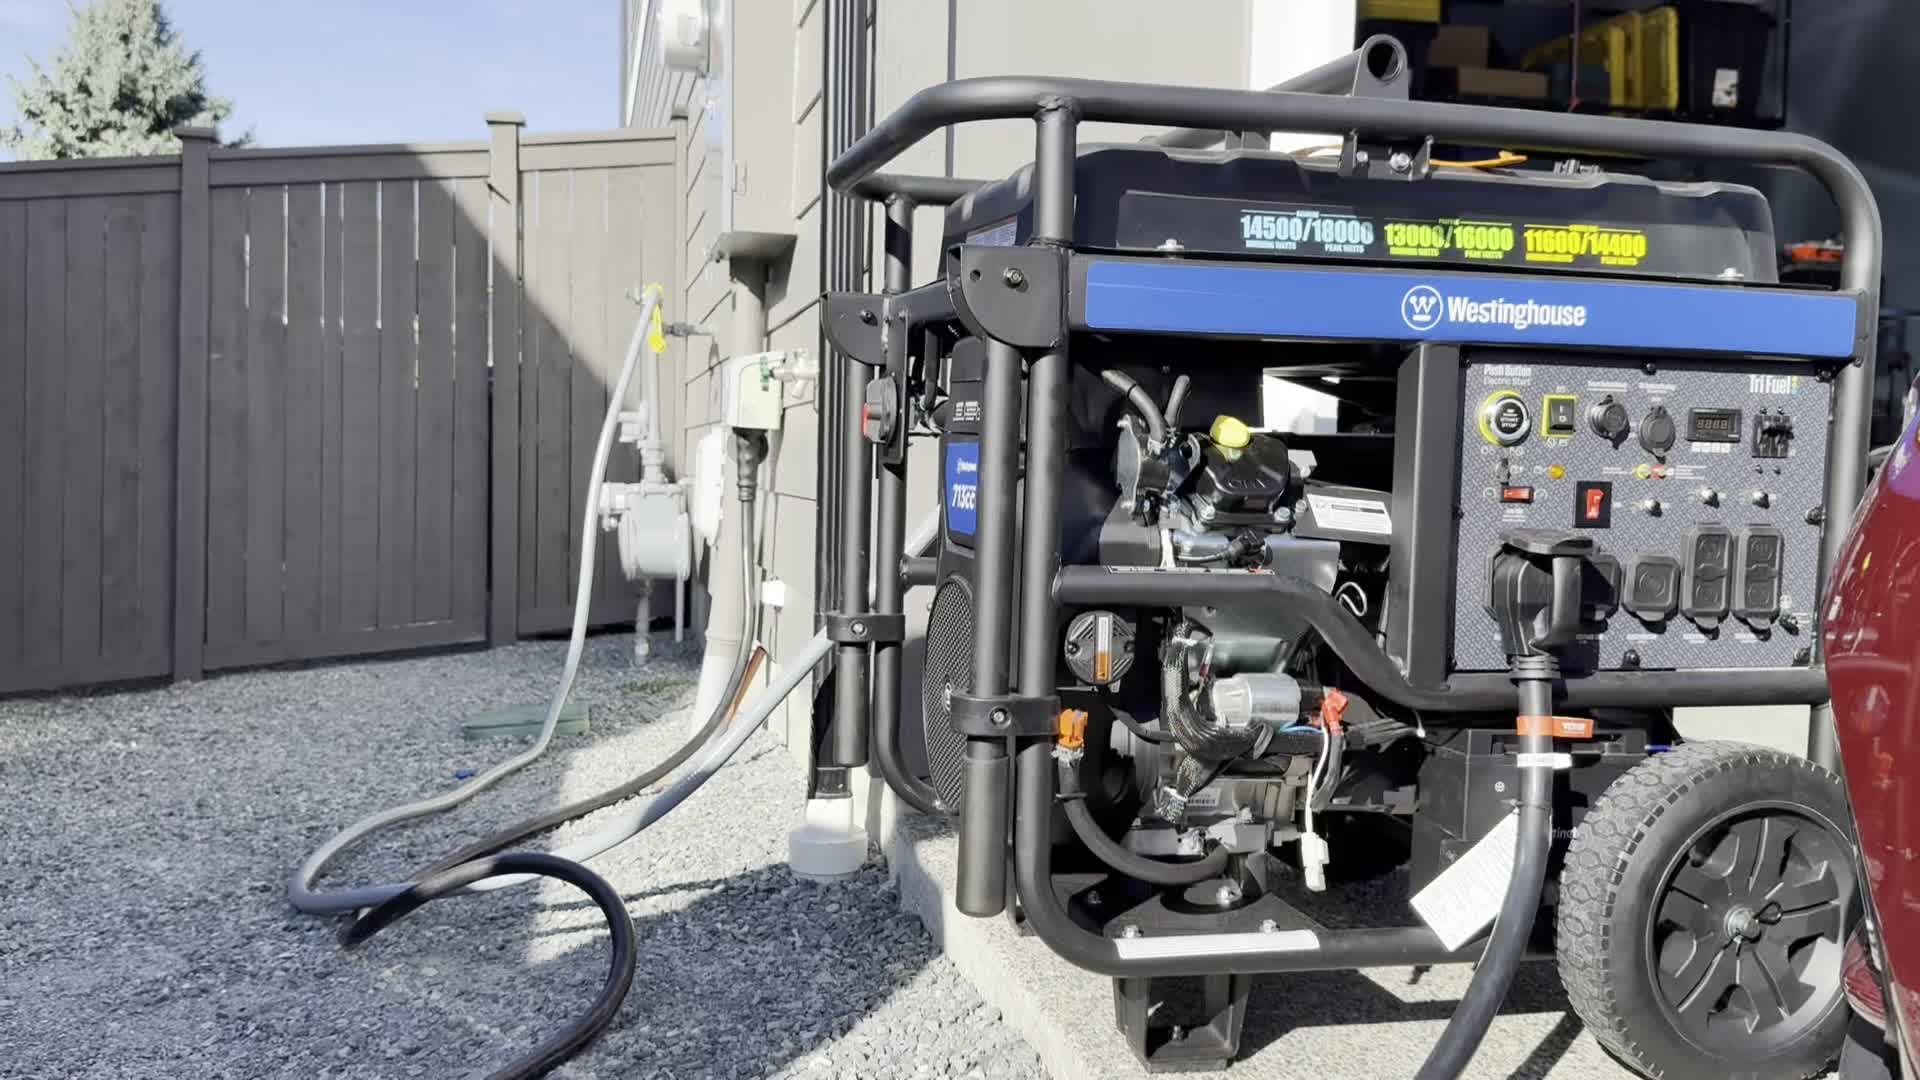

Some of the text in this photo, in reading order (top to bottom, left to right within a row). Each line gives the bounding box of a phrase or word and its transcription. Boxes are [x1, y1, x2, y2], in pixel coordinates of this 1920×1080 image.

[1240, 215, 1374, 245] 14500/18000
[1384, 223, 1514, 251] 13000/16000
[1524, 229, 1647, 258] 11600/14400
[1447, 296, 1588, 330] Westinghouse
[1484, 364, 1532, 377] Push Button
[1749, 374, 1790, 394] Tri Fuel
